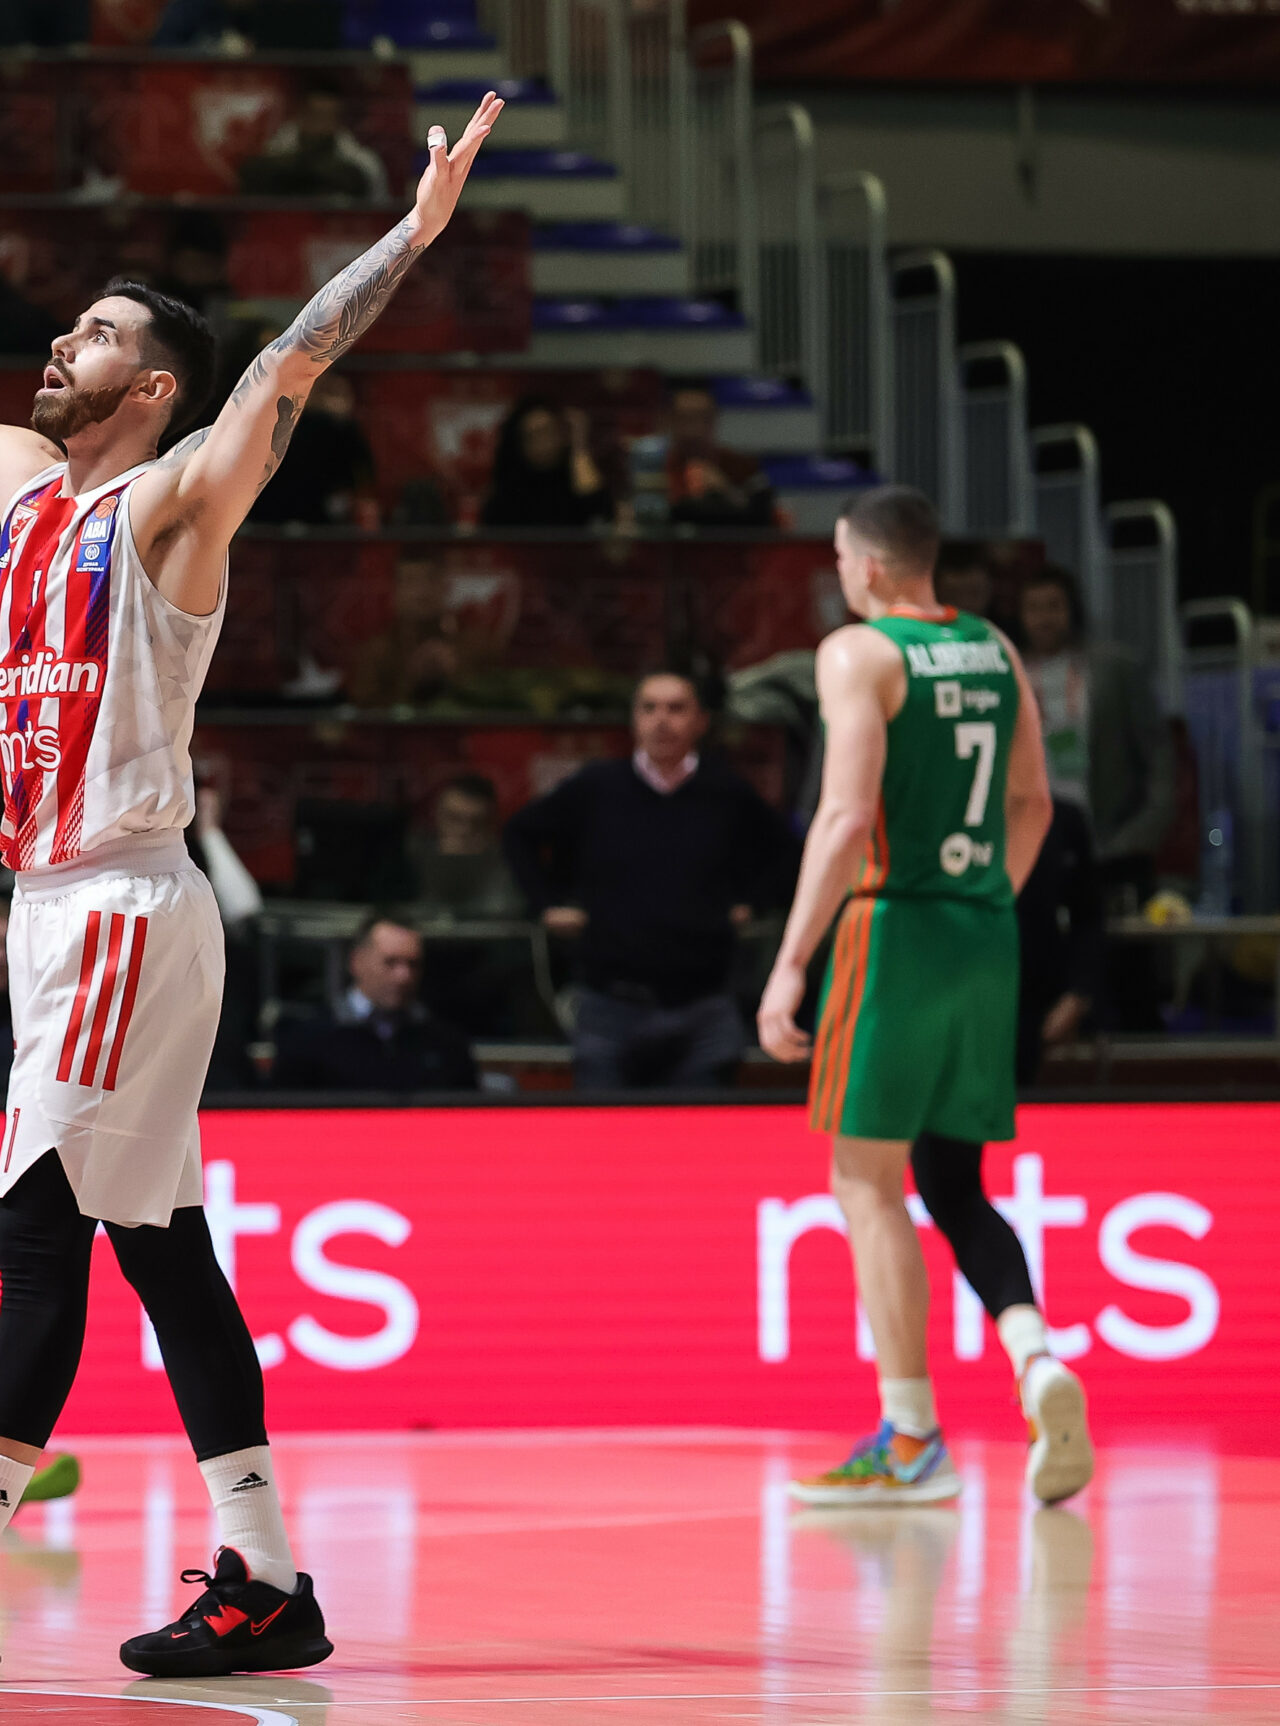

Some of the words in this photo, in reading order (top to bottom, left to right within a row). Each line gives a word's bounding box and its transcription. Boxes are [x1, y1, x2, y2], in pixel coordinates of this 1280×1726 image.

[83, 520, 107, 540] ABA
[954, 721, 997, 827] 7
[231, 1480, 268, 1493] adidas
